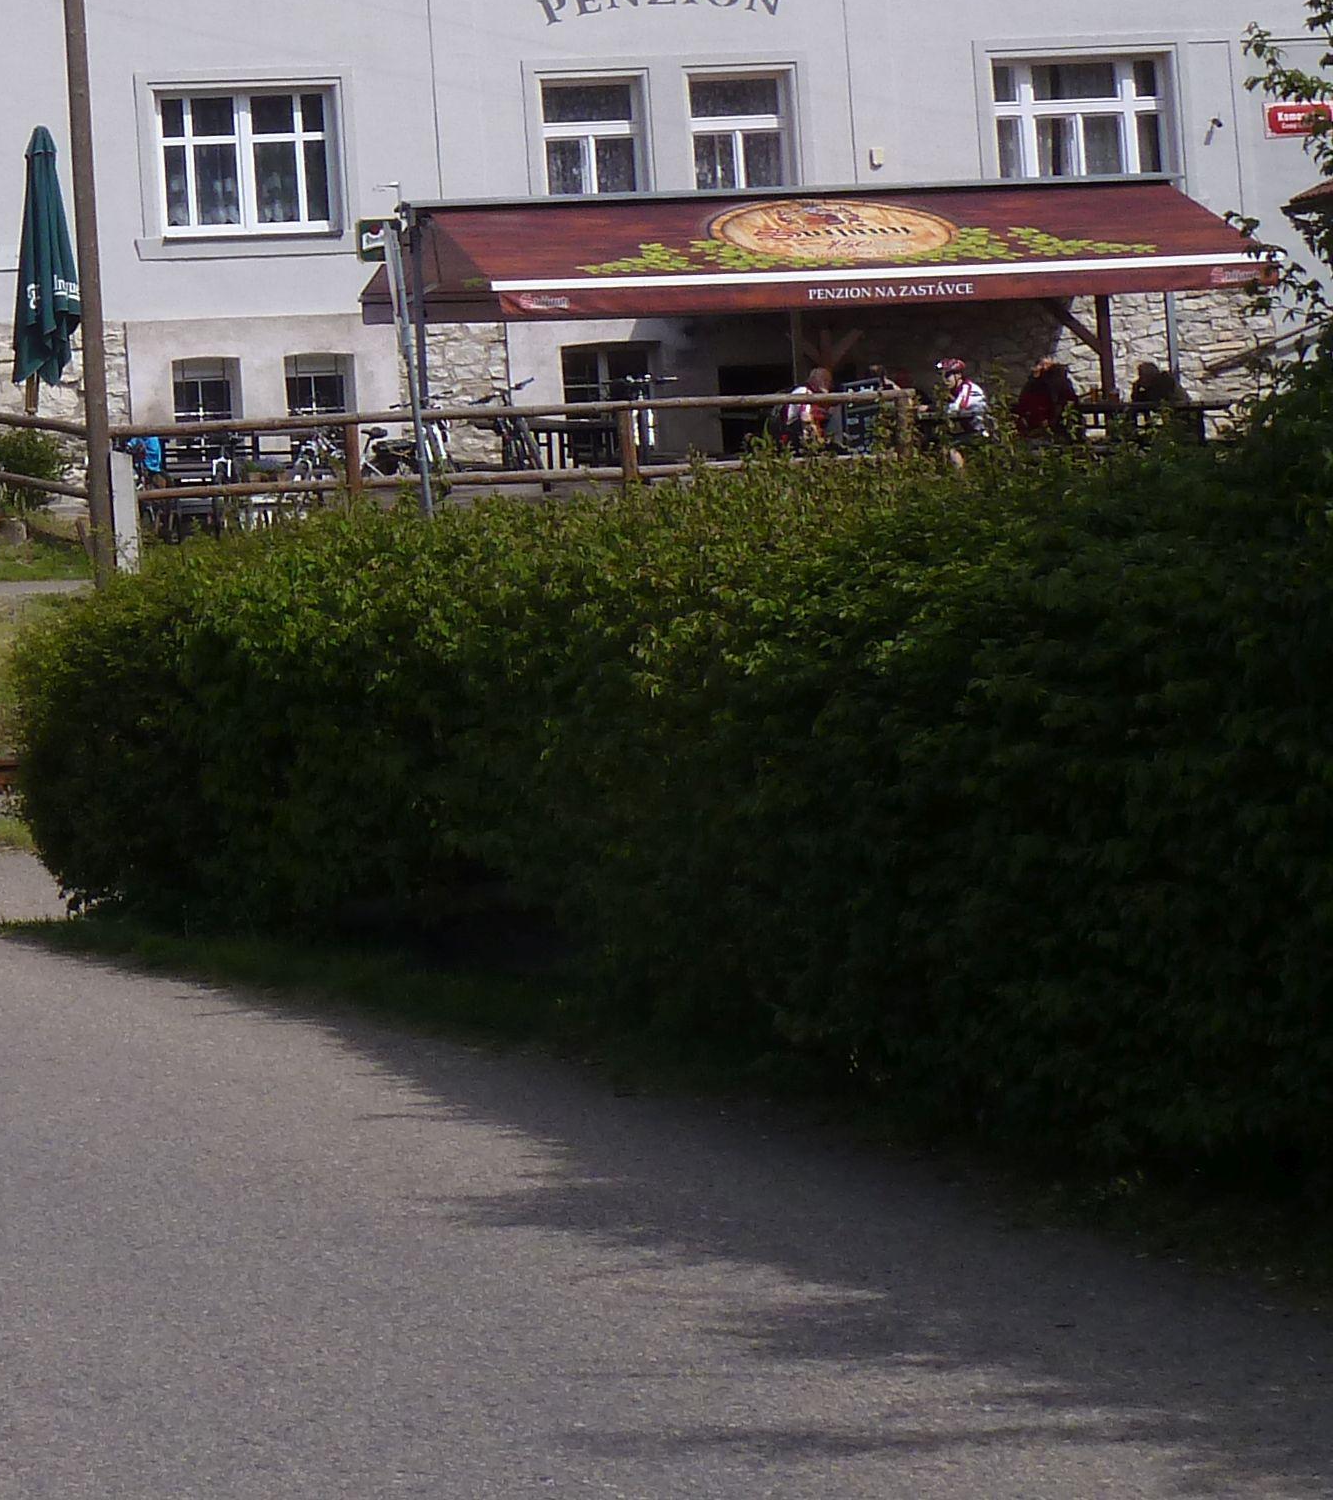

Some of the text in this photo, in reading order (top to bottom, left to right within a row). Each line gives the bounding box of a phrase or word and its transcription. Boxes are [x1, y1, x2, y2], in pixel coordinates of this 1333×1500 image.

[809, 281, 974, 300] PENZION NA ZASTÁVCE
